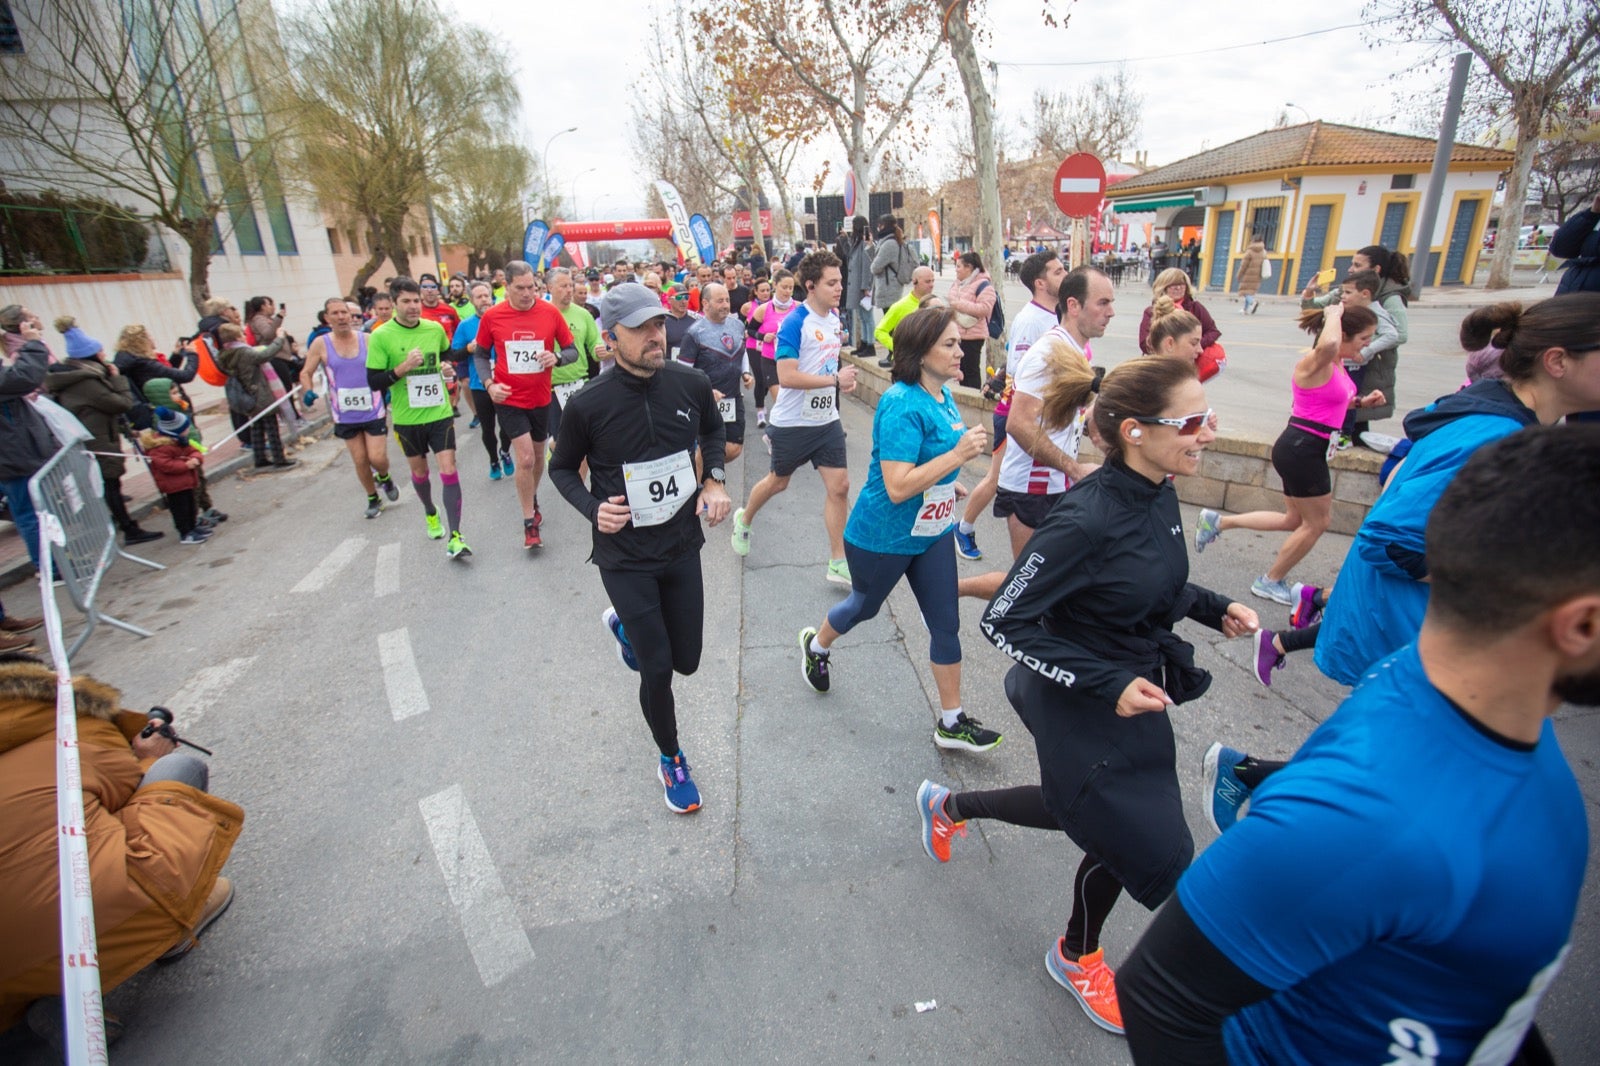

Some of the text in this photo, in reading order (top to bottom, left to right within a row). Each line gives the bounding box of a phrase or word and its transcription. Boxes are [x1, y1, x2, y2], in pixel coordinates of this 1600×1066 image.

[513, 350, 538, 363] 734
[344, 396, 366, 406] 651
[415, 384, 439, 396] 756
[810, 395, 833, 410] 689
[648, 475, 679, 503] 94
[920, 498, 954, 520] 209
[980, 621, 1076, 688] ARMOUR
[73, 850, 91, 899] DEPORTES
[82, 989, 107, 1065] DEPORTES
